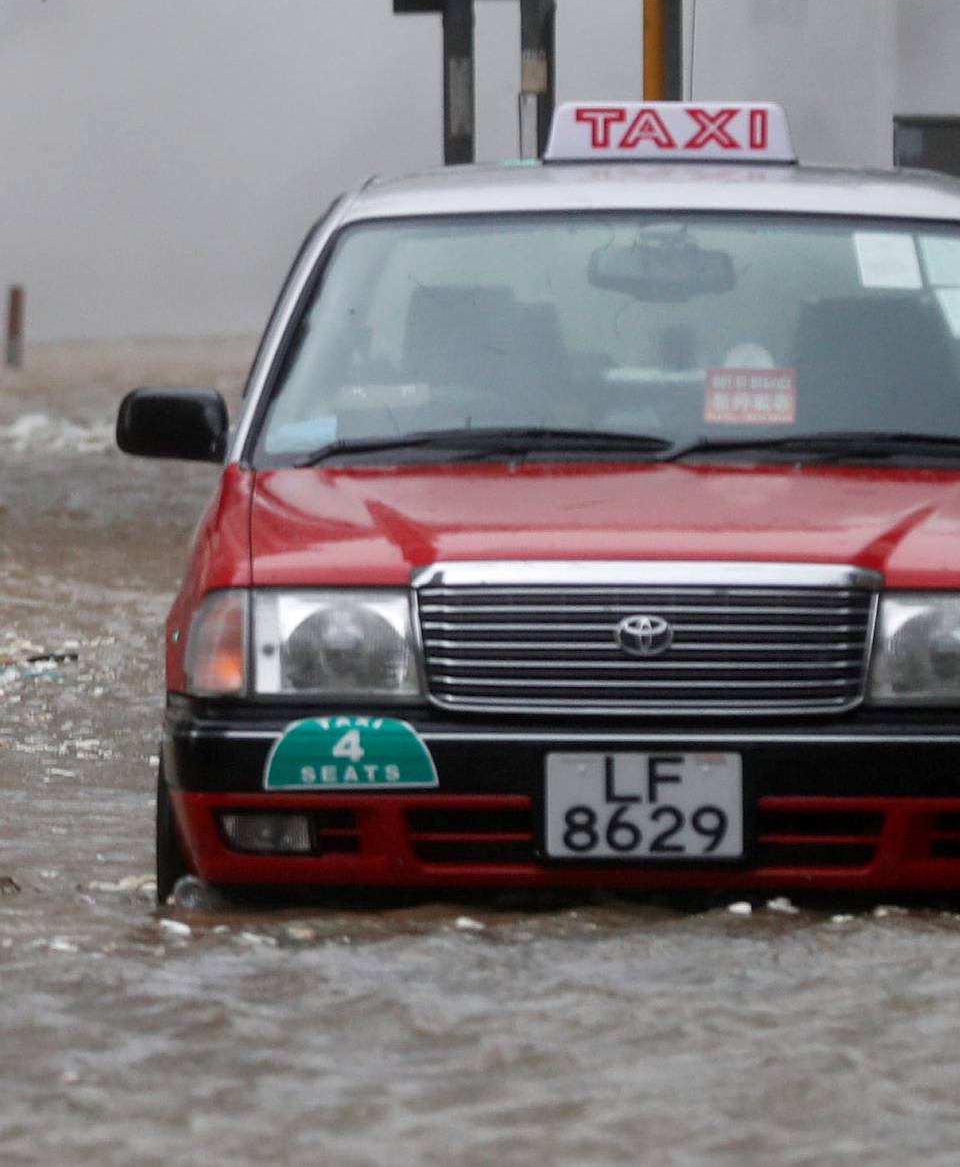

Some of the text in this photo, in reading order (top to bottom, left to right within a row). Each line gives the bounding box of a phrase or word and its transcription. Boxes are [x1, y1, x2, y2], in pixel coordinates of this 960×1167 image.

[575, 108, 769, 150] TAXI
[332, 728, 365, 764] 4
[300, 764, 400, 783] SEATS
[605, 756, 685, 803] LF
[563, 805, 728, 852] 8629
